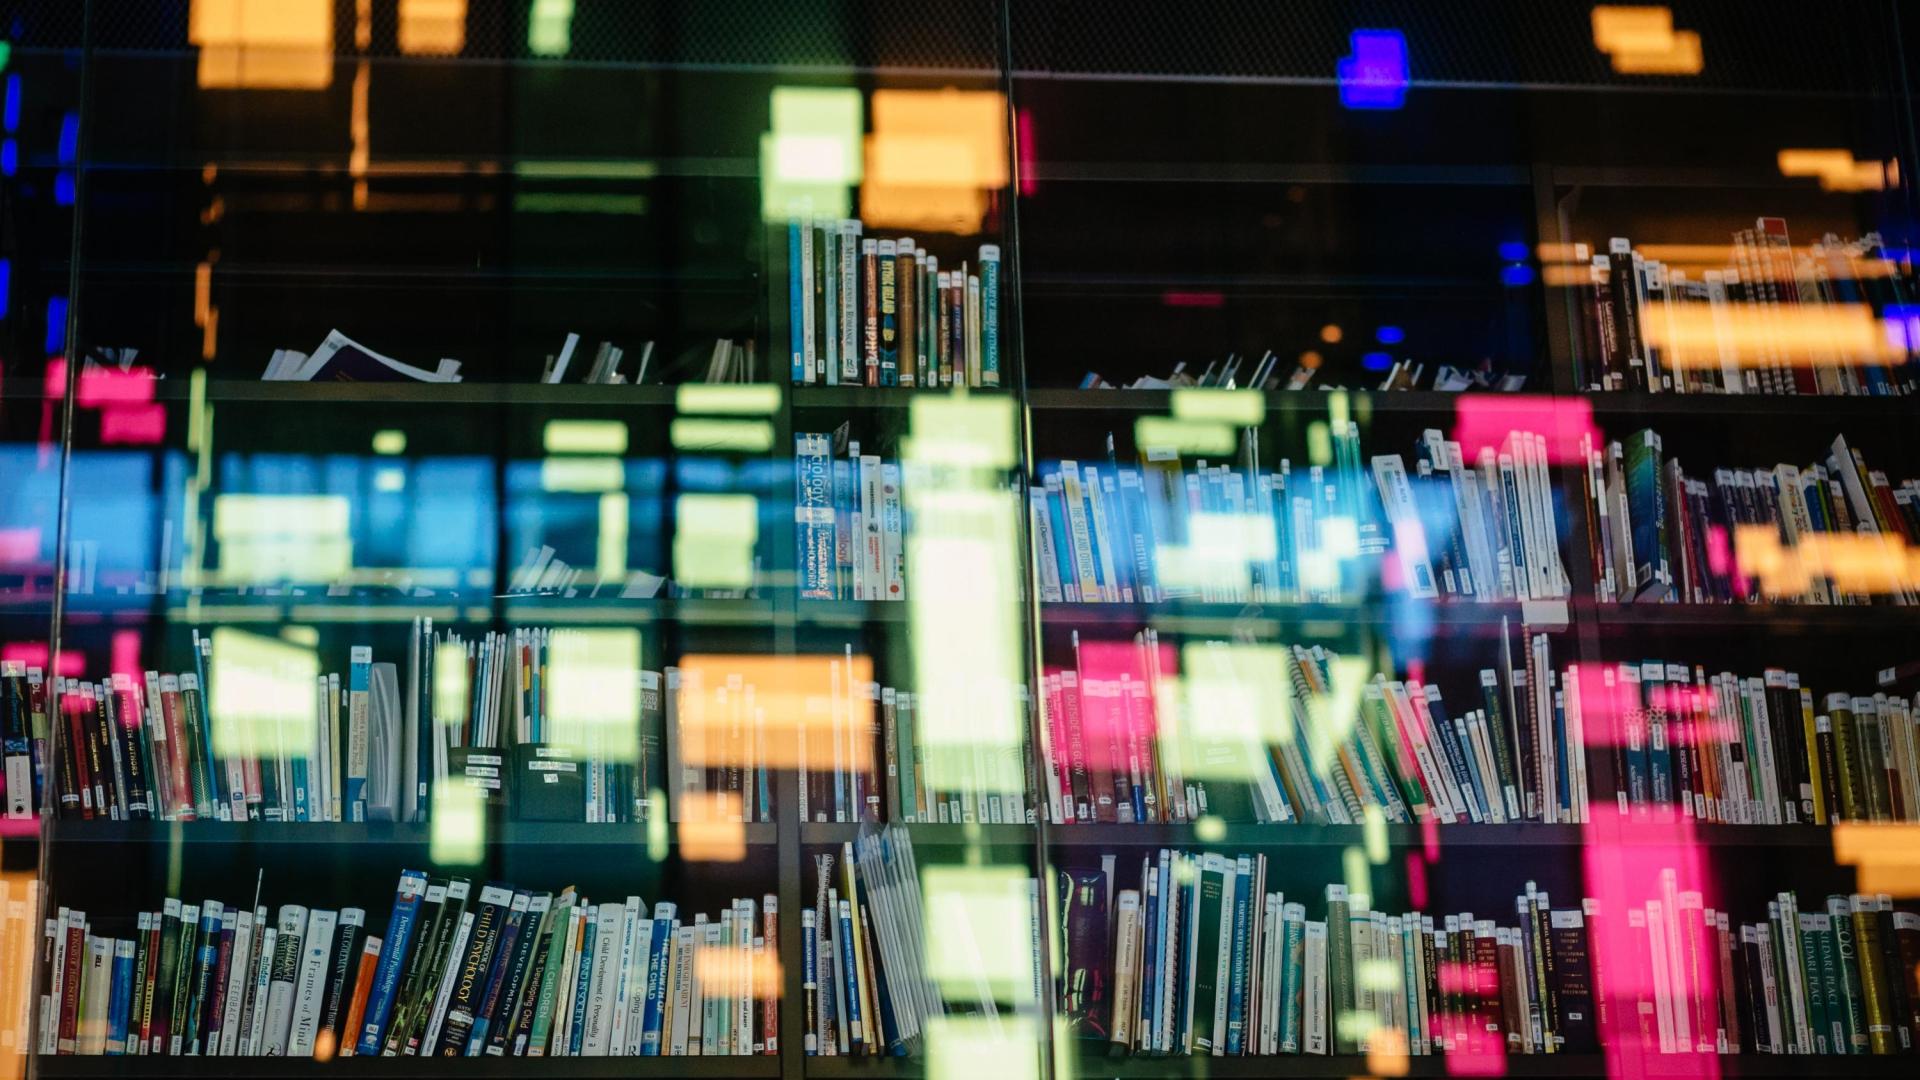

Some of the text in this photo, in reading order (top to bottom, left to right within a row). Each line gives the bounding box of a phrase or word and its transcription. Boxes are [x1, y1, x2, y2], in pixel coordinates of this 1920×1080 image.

[846, 311, 854, 345] ROMANCE
[1071, 507, 1082, 519] THE
[1066, 694, 1084, 776] OUTSIDE THE GLOW
[127, 740, 138, 776] AUTHORS
[1679, 749, 1689, 778] RESEARCH
[281, 935, 300, 982] EMOTIONAL
[380, 915, 410, 994] Developmental Psychology
[456, 903, 495, 1003] CHILD PSYCHOLOGY
[477, 928, 495, 973] HANDBOOK OF
[600, 936, 610, 954] Child
[258, 955, 270, 986] mindset
[501, 940, 529, 1019] DEVELOPMENT
[519, 950, 548, 1029] The Developing Child
[594, 955, 608, 994] Development
[647, 951, 660, 1000] THE CHILD
[657, 957, 668, 1000] GROWTH
[681, 955, 691, 983] ENOUGH
[225, 978, 241, 1025] FEEDBACK
[296, 960, 320, 1047] Frames of Mind
[537, 970, 555, 1020] CHILDREN
[572, 992, 586, 1025] SOCIETY
[656, 1002, 664, 1014] OF
[1824, 974, 1840, 1006] PLACE
[589, 1004, 602, 1038] Personality
